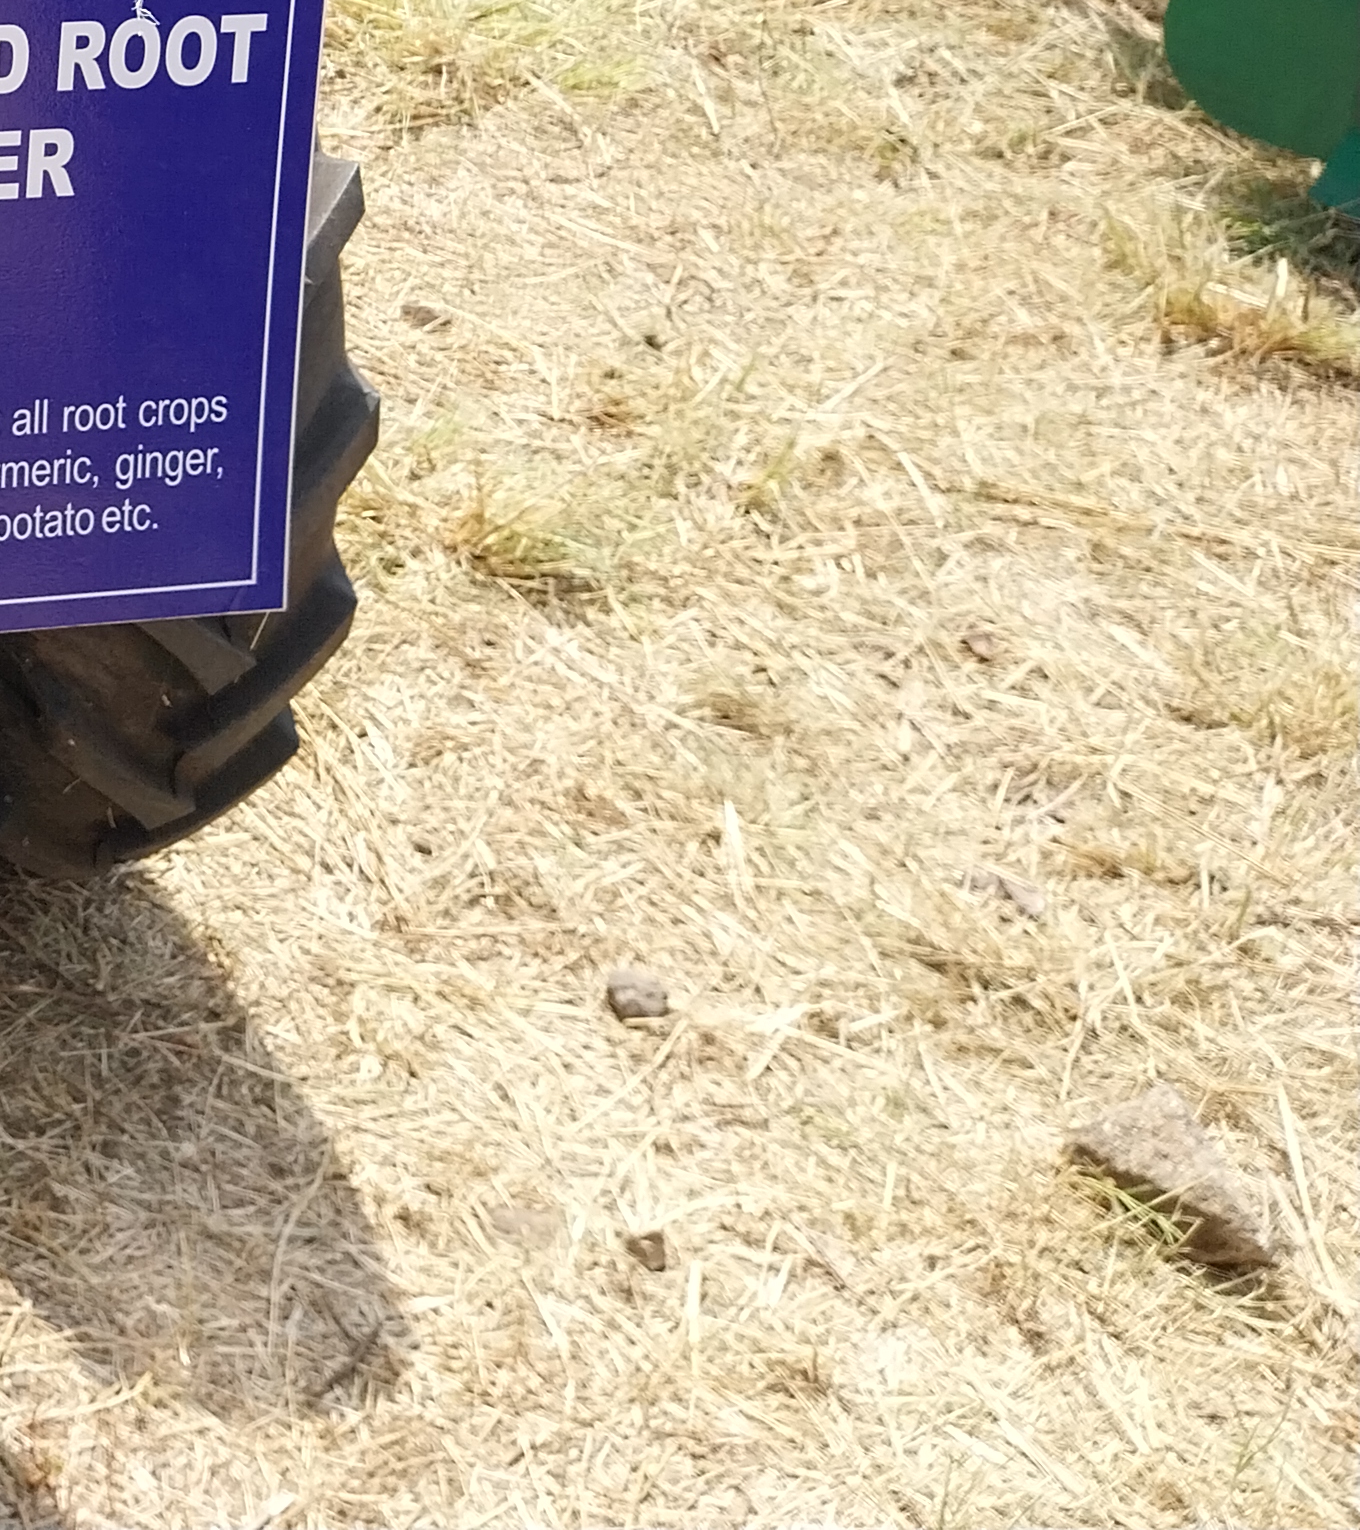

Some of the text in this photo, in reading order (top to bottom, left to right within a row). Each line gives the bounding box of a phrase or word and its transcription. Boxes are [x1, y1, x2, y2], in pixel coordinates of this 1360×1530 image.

[57, 12, 267, 91] ROOT
[12, 398, 49, 436] all
[62, 396, 127, 432] root
[138, 396, 228, 433] crops
[116, 445, 223, 490] ginger,
[101, 498, 159, 533] etc.
